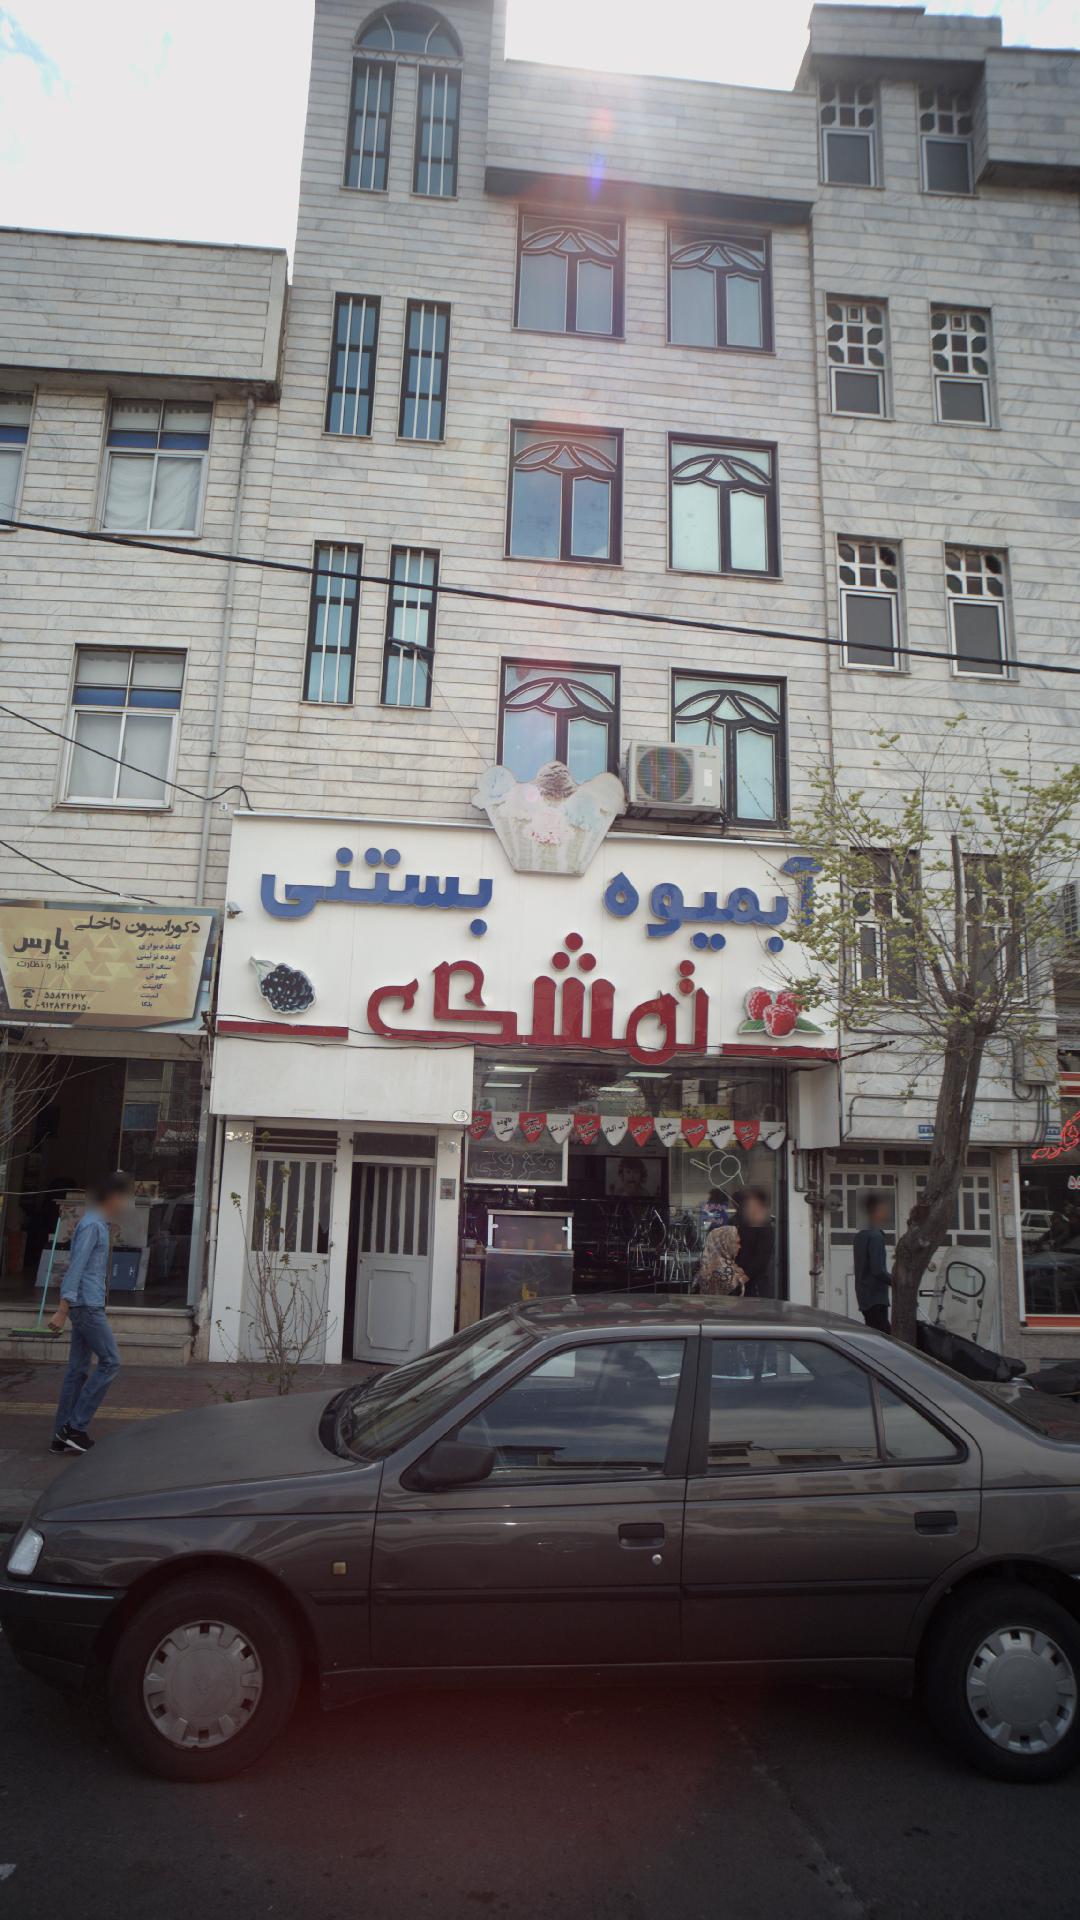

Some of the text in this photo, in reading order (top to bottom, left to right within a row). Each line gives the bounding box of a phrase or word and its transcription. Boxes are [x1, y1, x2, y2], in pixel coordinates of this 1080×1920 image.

[260, 847, 823, 954] آبمیوه بستنی
[74, 915, 201, 937] دکوراسیون داخلی
[13, 927, 70, 959] پارس
[16, 960, 44, 968] نظارت
[55, 962, 70, 971] اجرا
[367, 932, 710, 1065] تمشک
[711, 1124, 731, 1138] معجون
